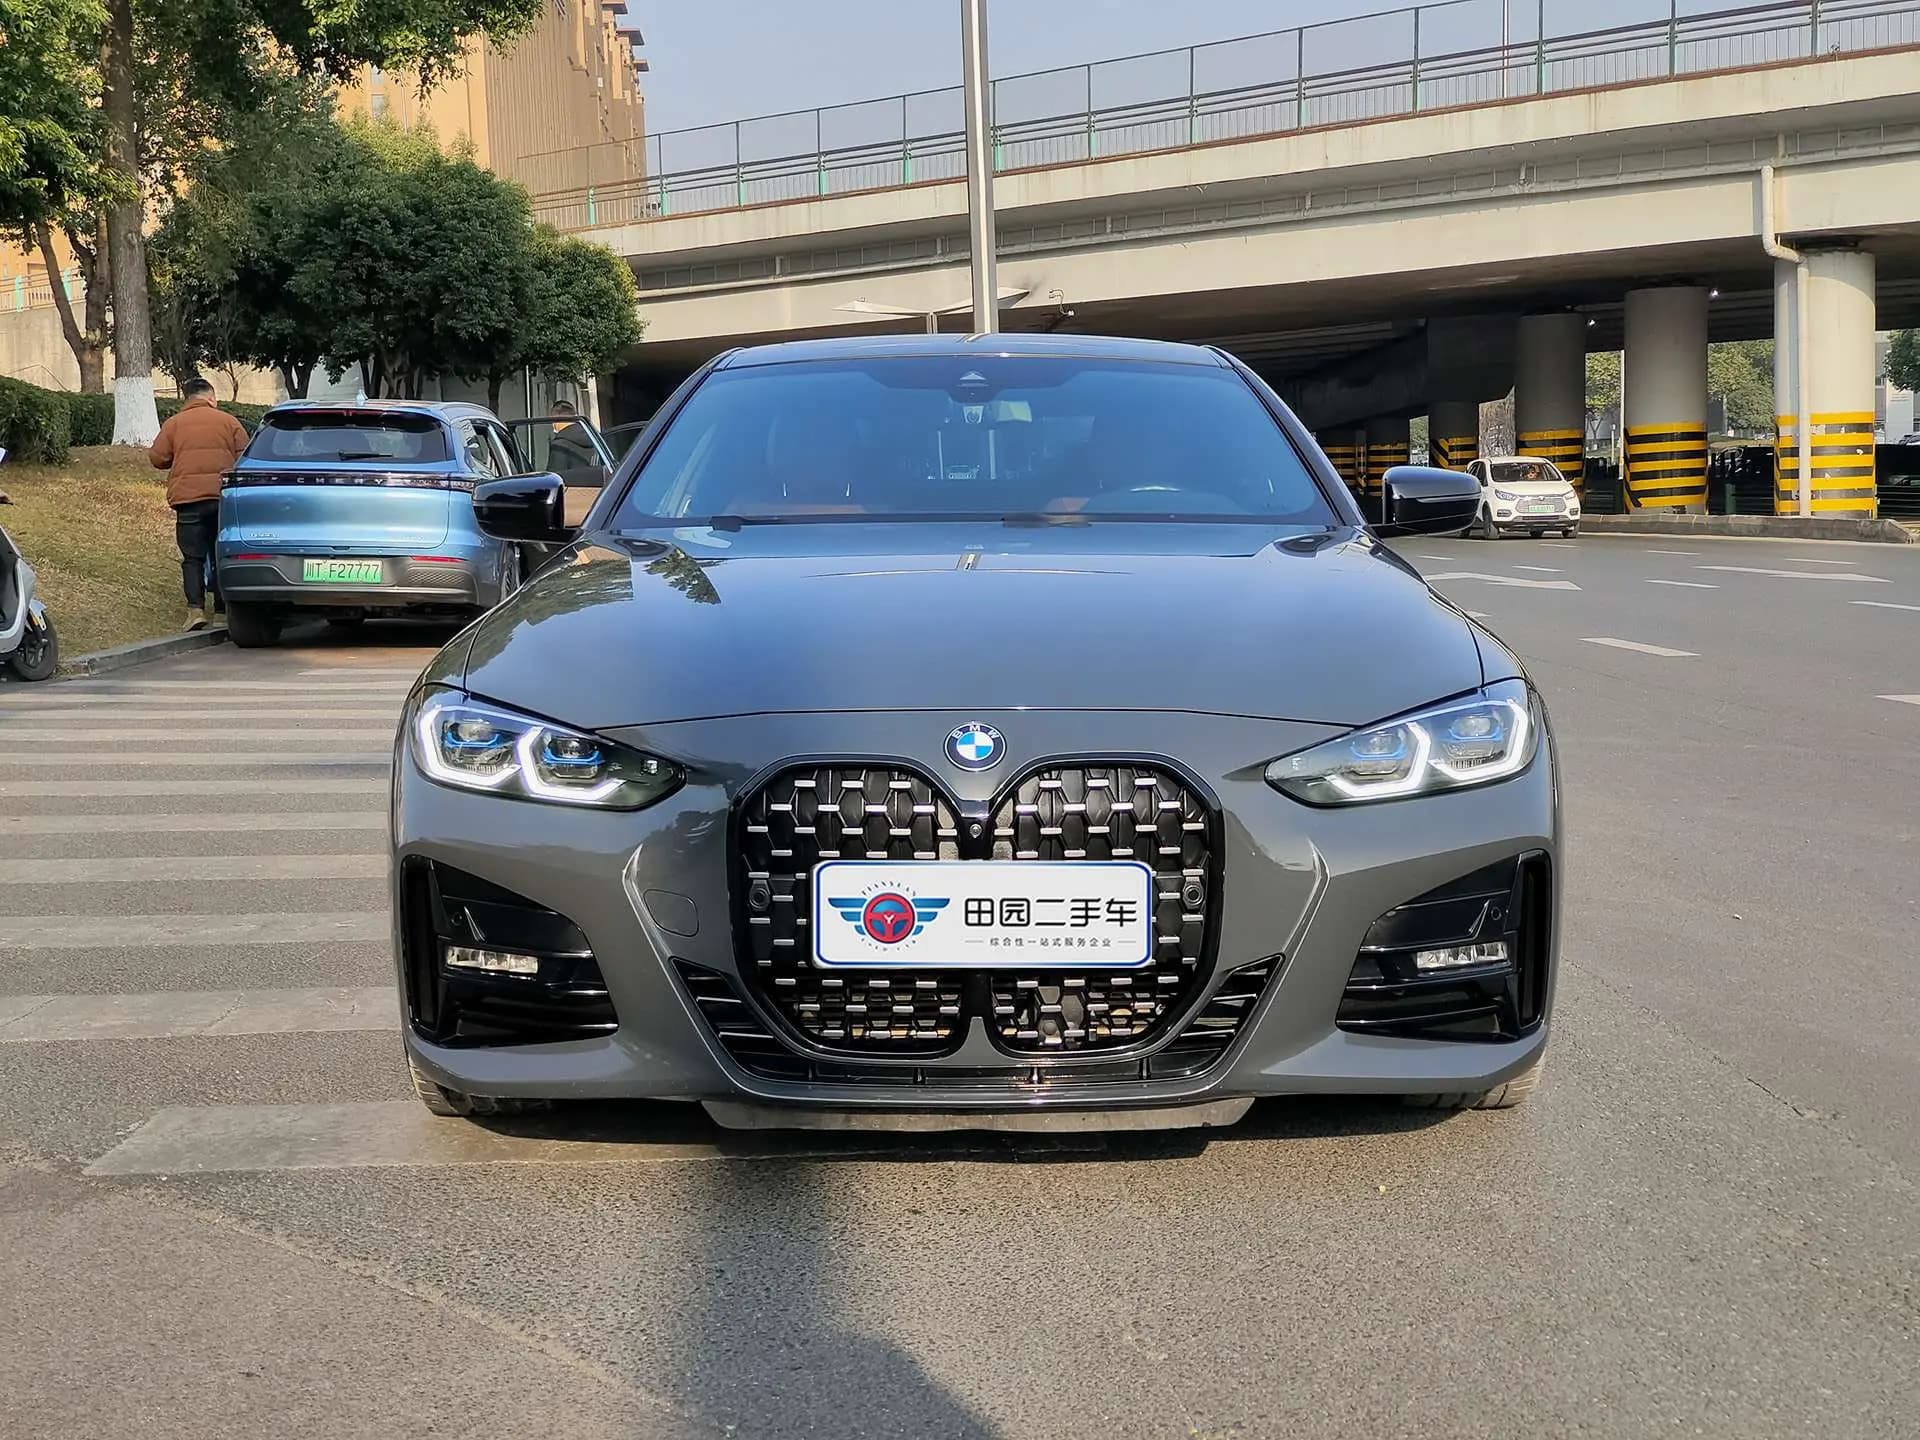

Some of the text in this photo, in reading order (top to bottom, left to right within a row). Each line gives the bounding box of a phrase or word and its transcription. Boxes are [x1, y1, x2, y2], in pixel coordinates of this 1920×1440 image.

[951, 723, 1000, 739] BMW
[965, 897, 1137, 928] 田园二手车
[990, 936, 1112, 948] 综合性一站式服务企业
